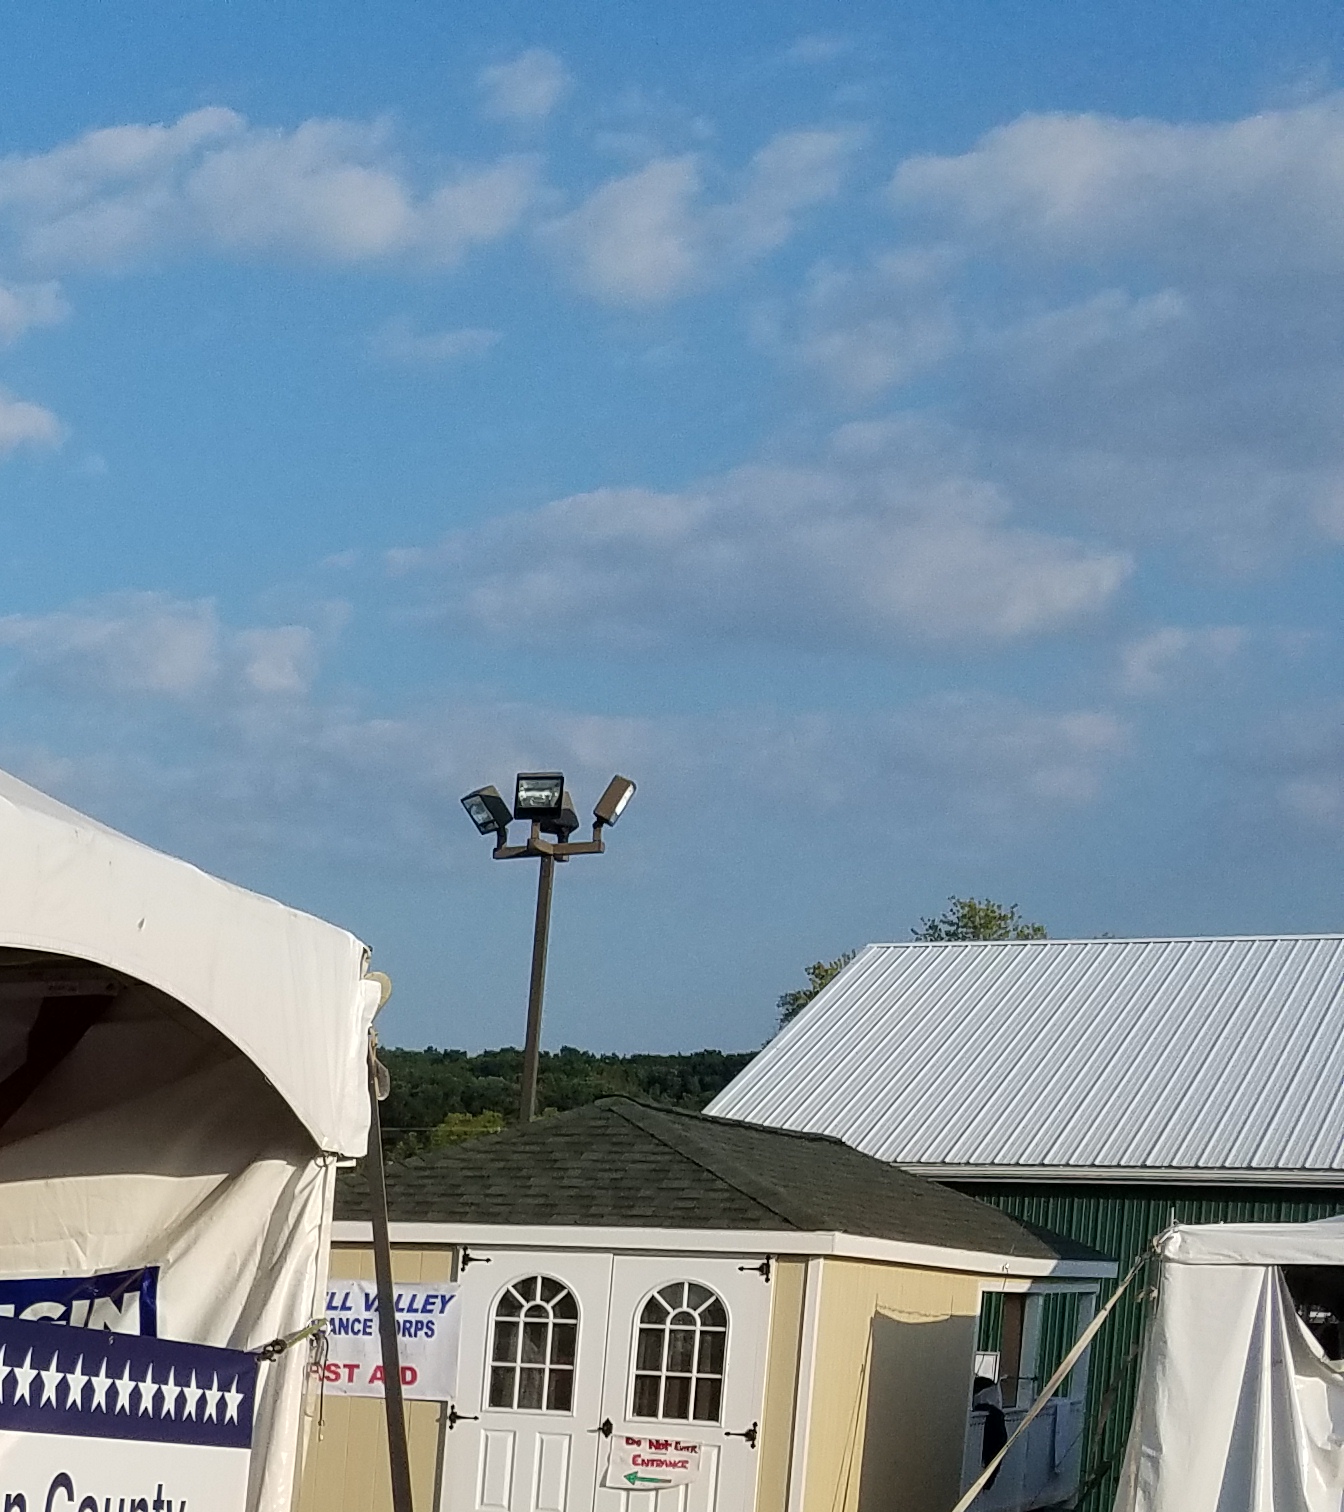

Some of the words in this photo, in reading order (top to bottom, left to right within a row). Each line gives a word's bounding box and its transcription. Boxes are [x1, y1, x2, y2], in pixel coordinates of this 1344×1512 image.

[326, 1292, 353, 1311] LL
[364, 1292, 456, 1314] VLLEY
[368, 1365, 418, 1385] AD
